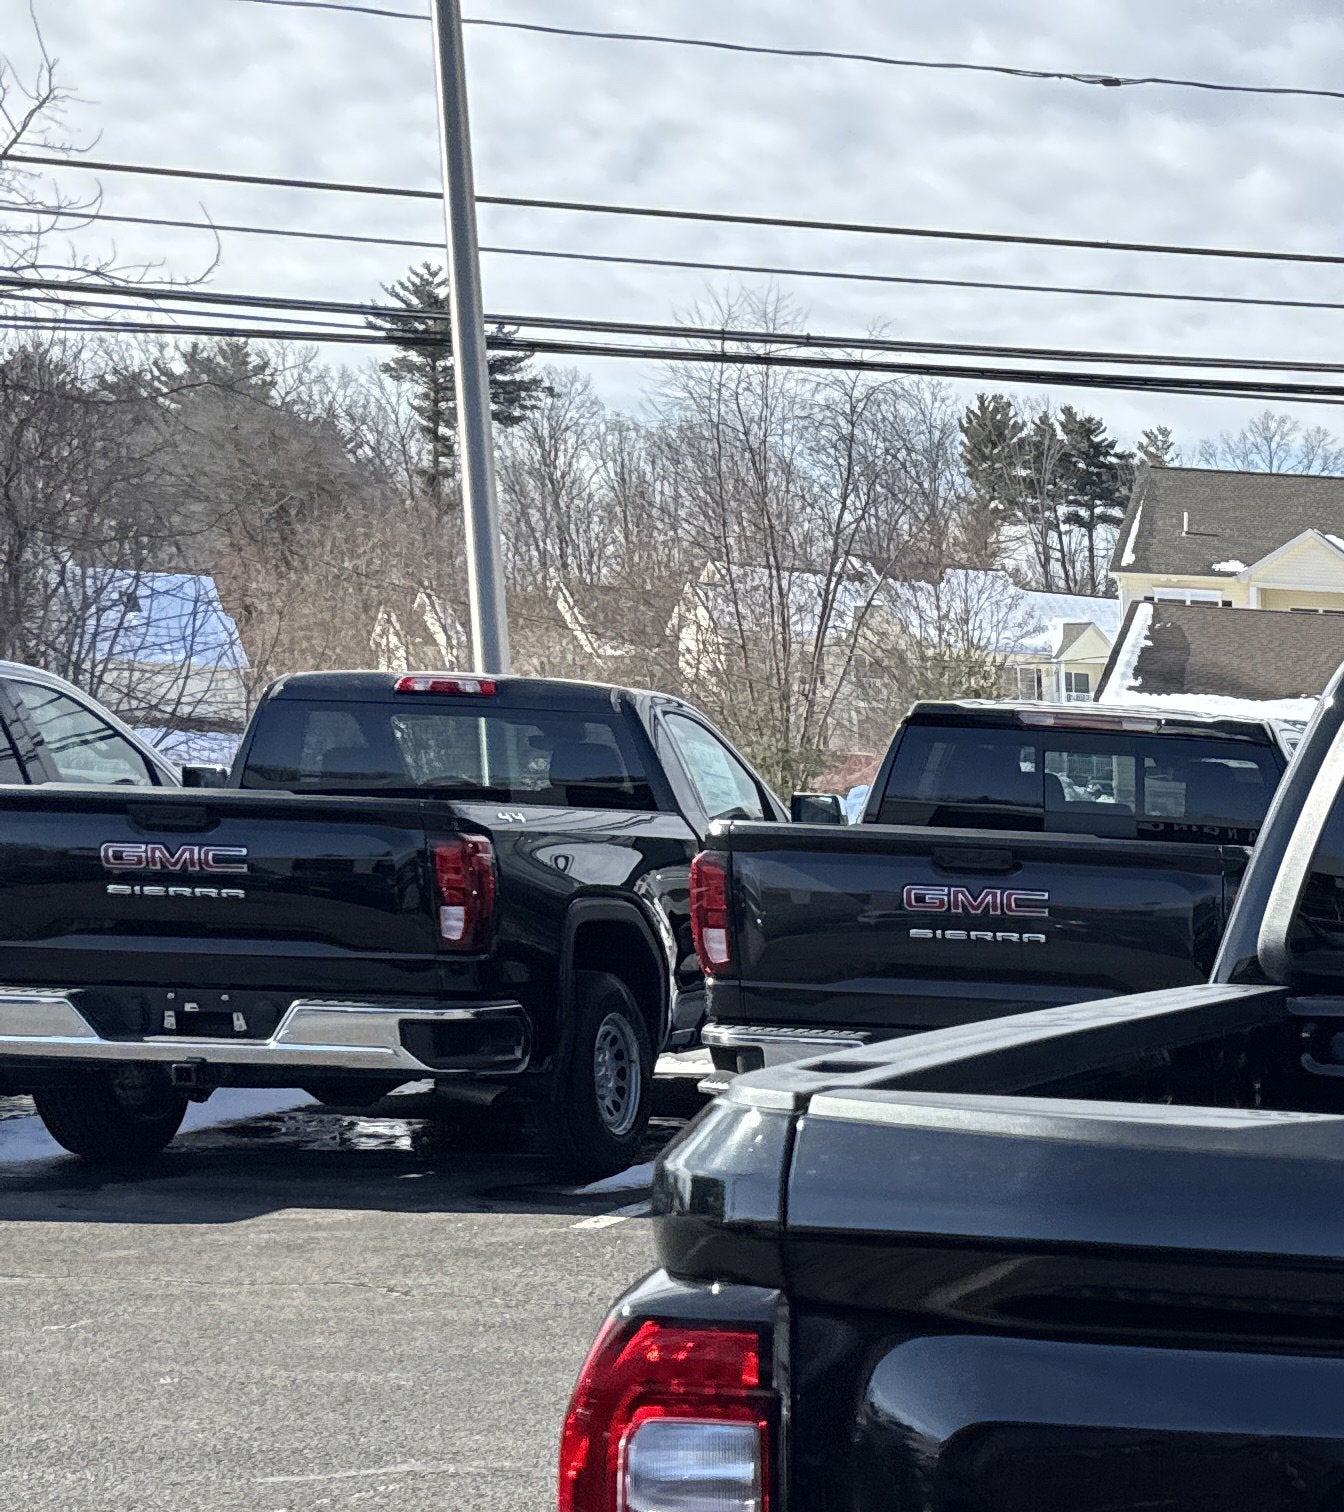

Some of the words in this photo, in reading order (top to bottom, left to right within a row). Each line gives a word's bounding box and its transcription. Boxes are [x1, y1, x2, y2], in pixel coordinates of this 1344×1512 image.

[101, 842, 248, 873] GMC
[106, 884, 246, 899] SIERRA
[903, 885, 1049, 917] GMC
[909, 928, 1046, 943] SIERRA
